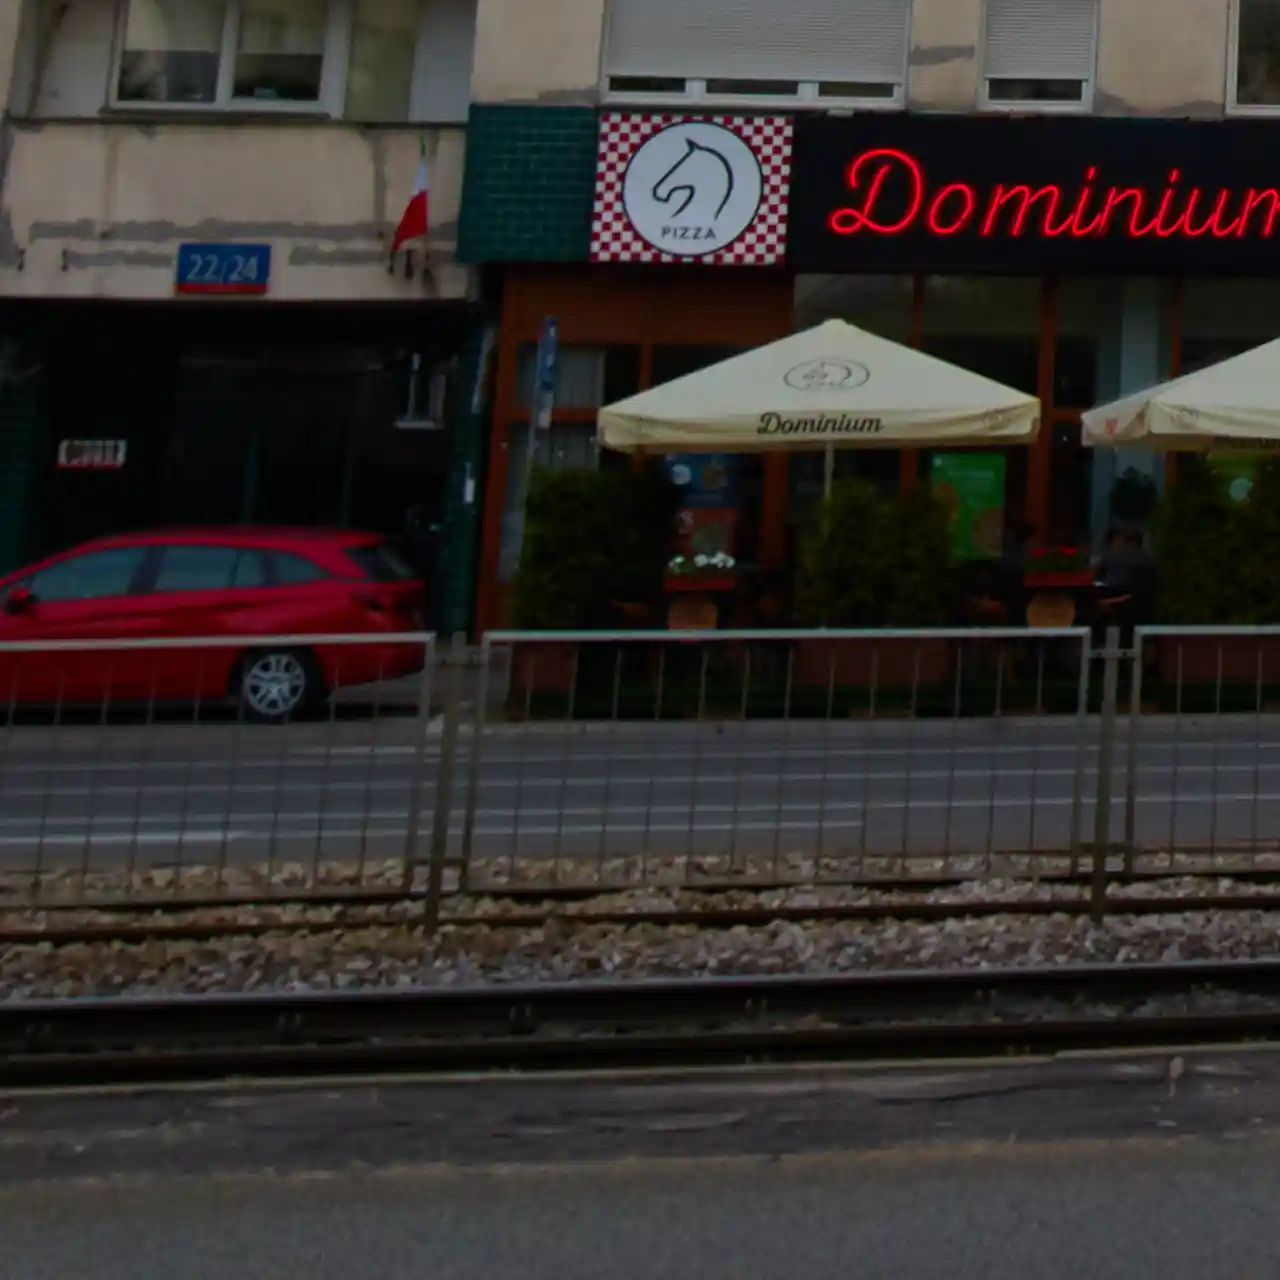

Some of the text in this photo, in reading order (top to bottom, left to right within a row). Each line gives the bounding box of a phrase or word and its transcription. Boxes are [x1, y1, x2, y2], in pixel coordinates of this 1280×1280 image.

[661, 226, 717, 240] PIZZA
[186, 254, 260, 283] 22/24
[757, 411, 883, 435] Dominium
